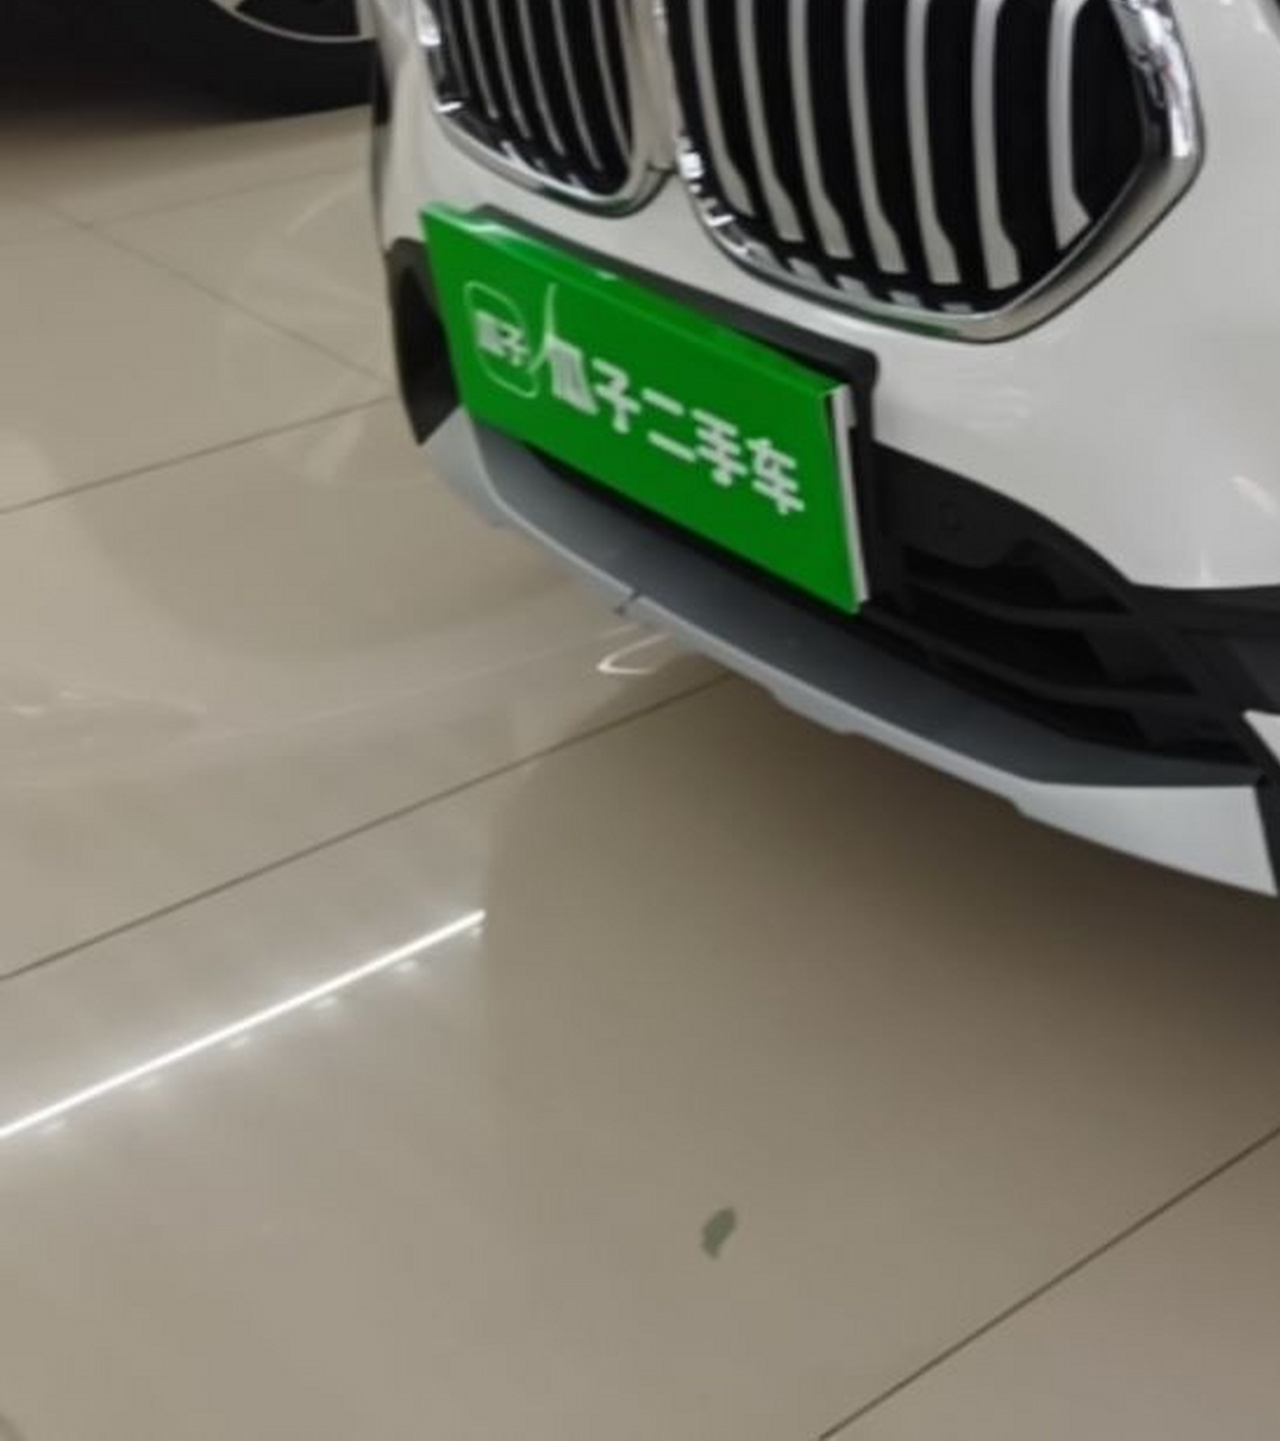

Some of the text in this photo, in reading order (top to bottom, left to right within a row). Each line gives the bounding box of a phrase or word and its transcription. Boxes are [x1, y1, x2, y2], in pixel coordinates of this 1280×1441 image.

[527, 282, 806, 516] 瓜子二手车
